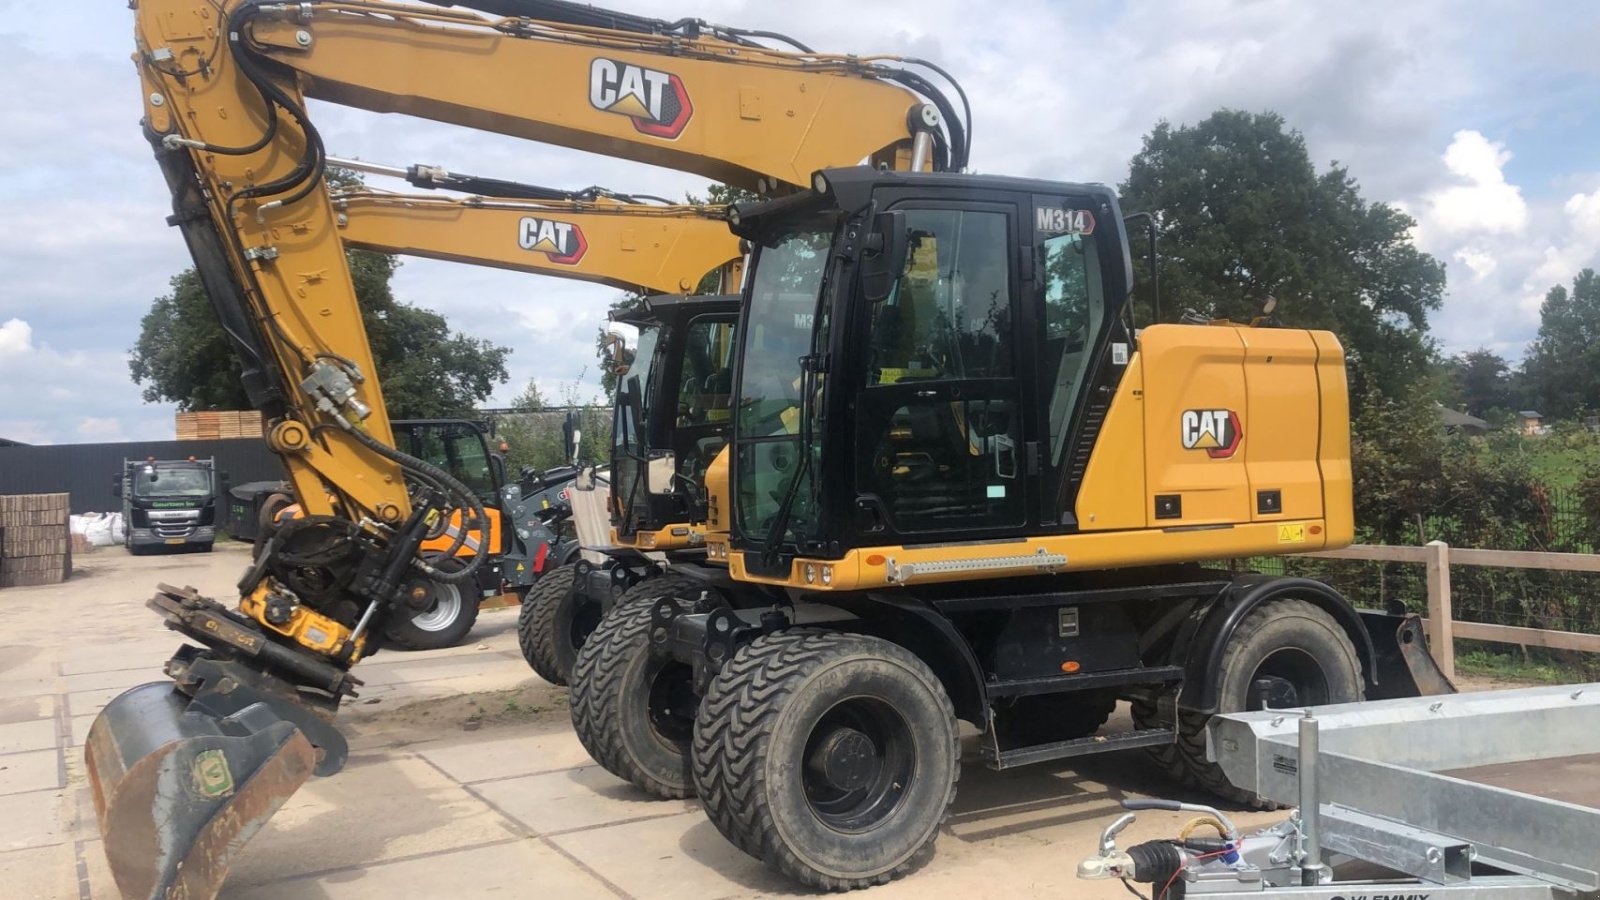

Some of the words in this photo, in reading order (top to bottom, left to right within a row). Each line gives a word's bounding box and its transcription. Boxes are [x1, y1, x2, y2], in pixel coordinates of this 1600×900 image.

[590, 58, 670, 121] CAT
[519, 217, 573, 255] CAT
[1037, 208, 1085, 232] M314
[1182, 410, 1229, 449] CAT
